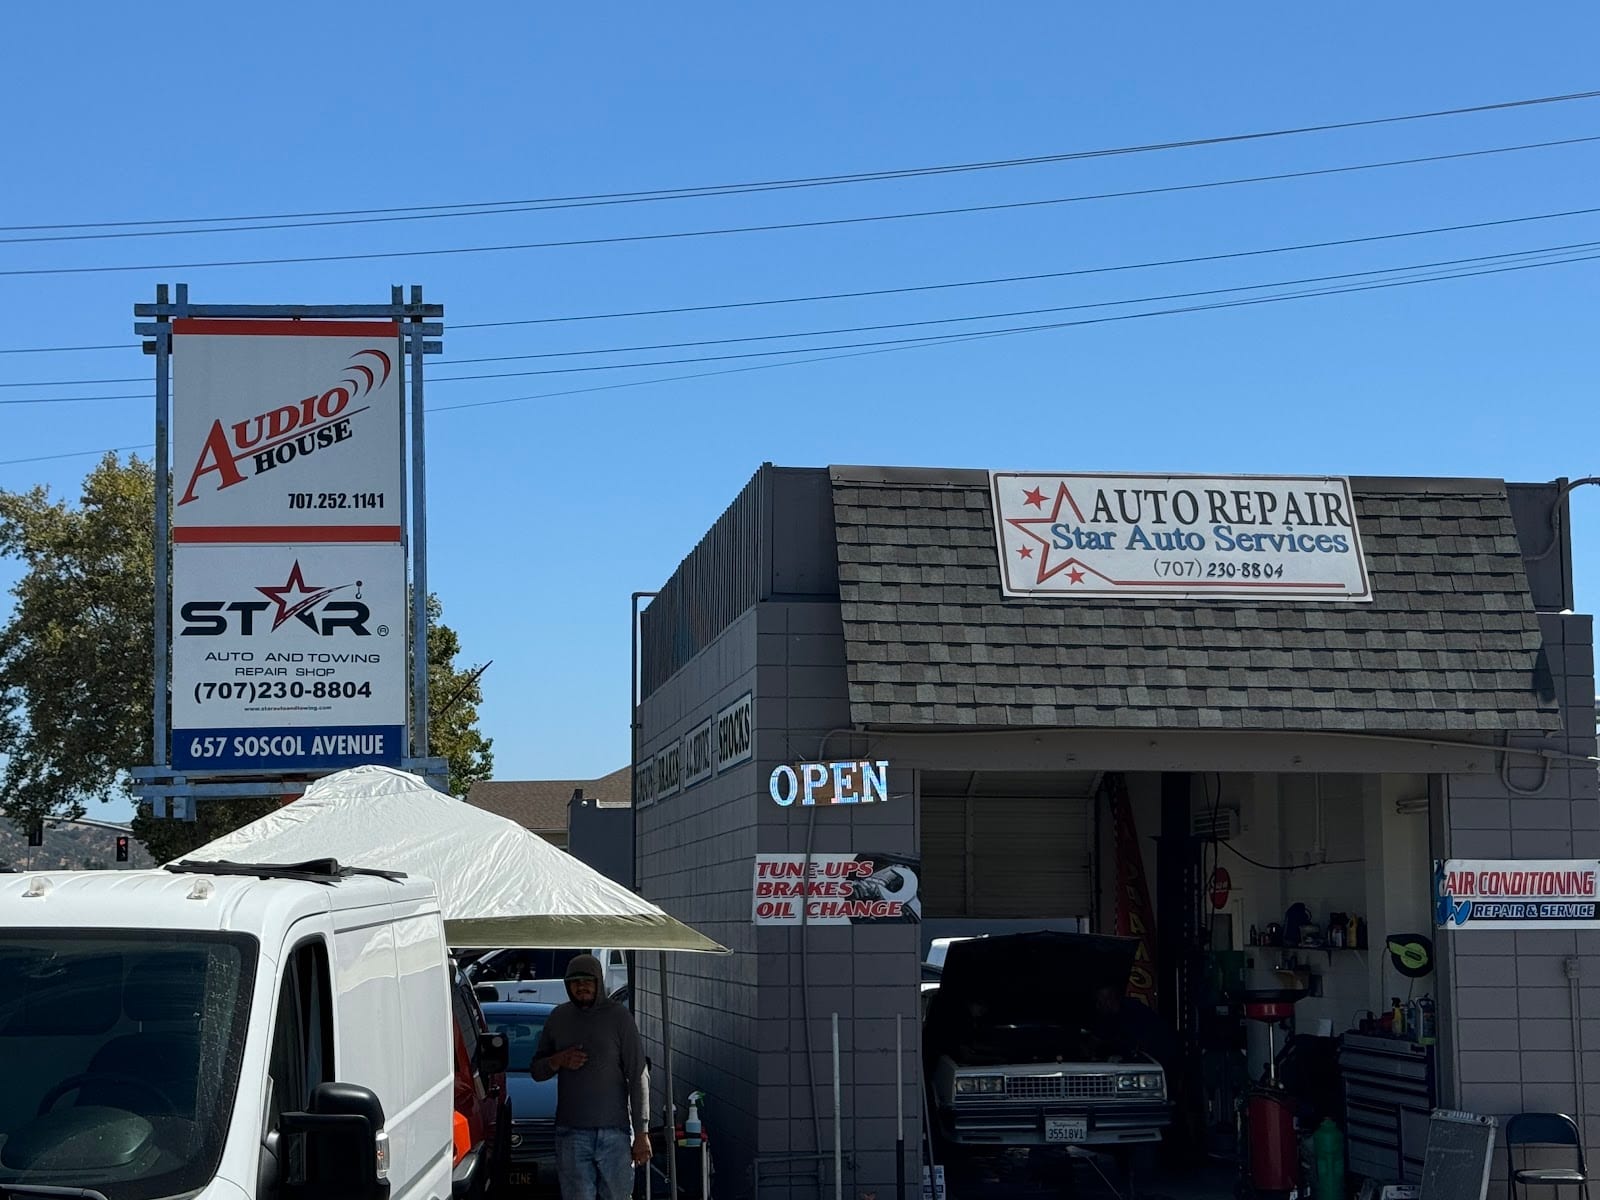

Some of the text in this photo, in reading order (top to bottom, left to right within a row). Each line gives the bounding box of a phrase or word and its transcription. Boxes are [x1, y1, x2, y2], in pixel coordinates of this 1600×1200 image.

[177, 387, 350, 507] AUDIO
[252, 418, 353, 475] HOUSE
[287, 493, 385, 509] 707.252.1141
[1090, 488, 1352, 528] AUTO REPAIR
[1050, 523, 1350, 554] Star Auto Services
[1153, 558, 1285, 579] (707) 230-8804
[180, 558, 372, 636] STAR
[205, 652, 381, 664] AUTO AND TOWING
[234, 667, 336, 677] REPAIR SHOP
[193, 681, 372, 704] (707)230-8804
[718, 702, 751, 764] SHOCKS
[190, 734, 385, 758] 657 SOSCOL AVENUE
[769, 760, 889, 806] OPEN
[757, 861, 874, 878] TUNE-UPS
[756, 882, 853, 896] BRAKES
[1446, 871, 1595, 896] AIR CONDITIONING
[756, 901, 902, 917] OIL CHANGE
[1473, 904, 1595, 918] REPAIR & SERVICE
